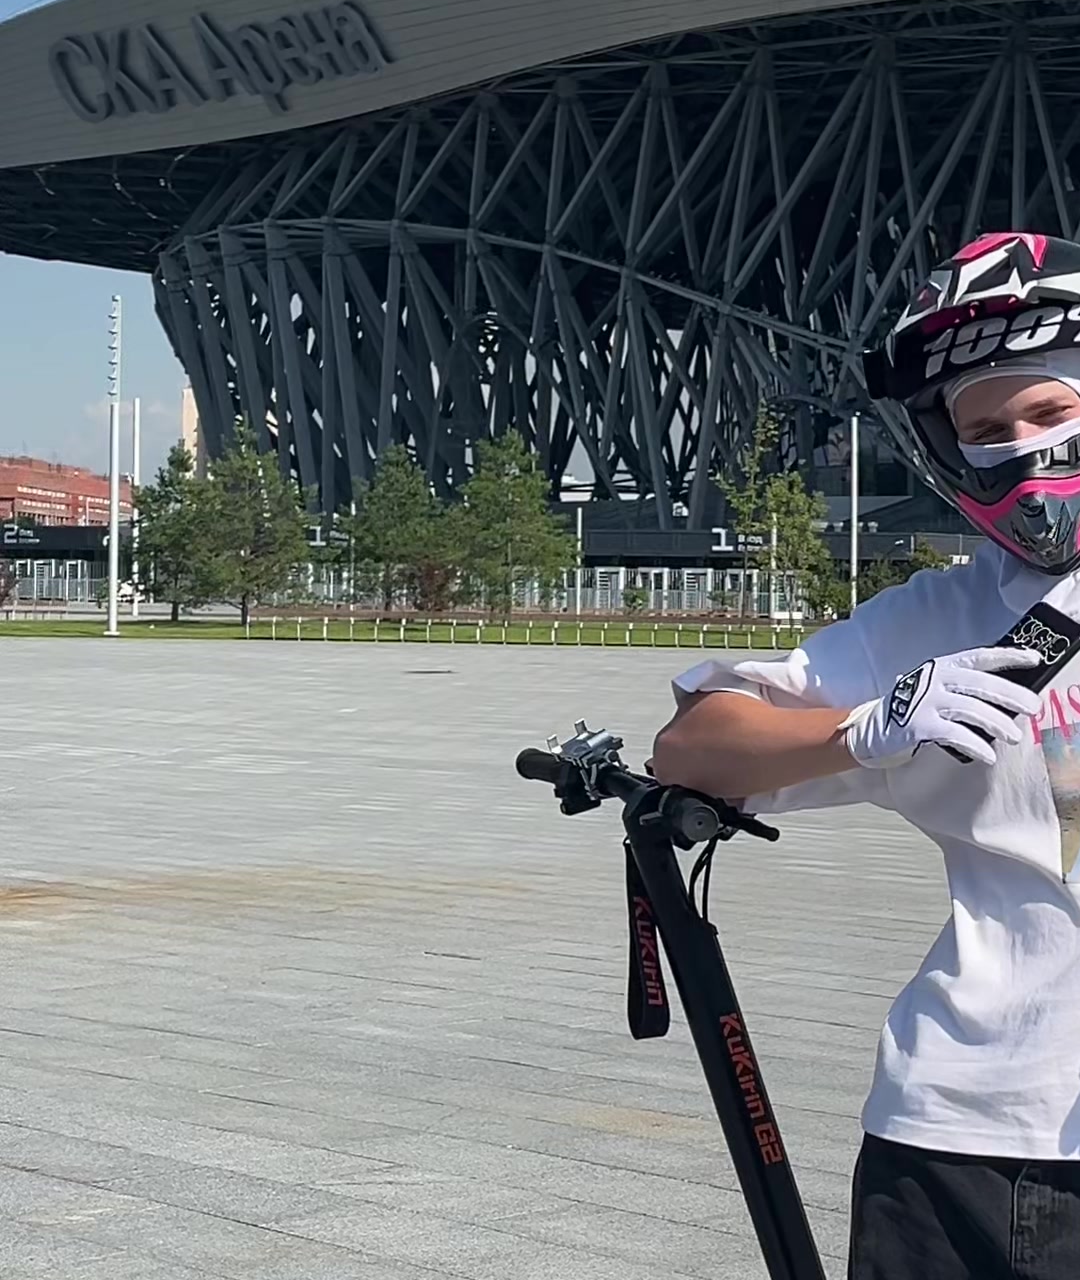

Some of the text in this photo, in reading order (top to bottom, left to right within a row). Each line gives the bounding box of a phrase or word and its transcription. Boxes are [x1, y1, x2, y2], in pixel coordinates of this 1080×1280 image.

[51, 1, 394, 123] СКА Арена
[754, 1123, 783, 1164] G2
